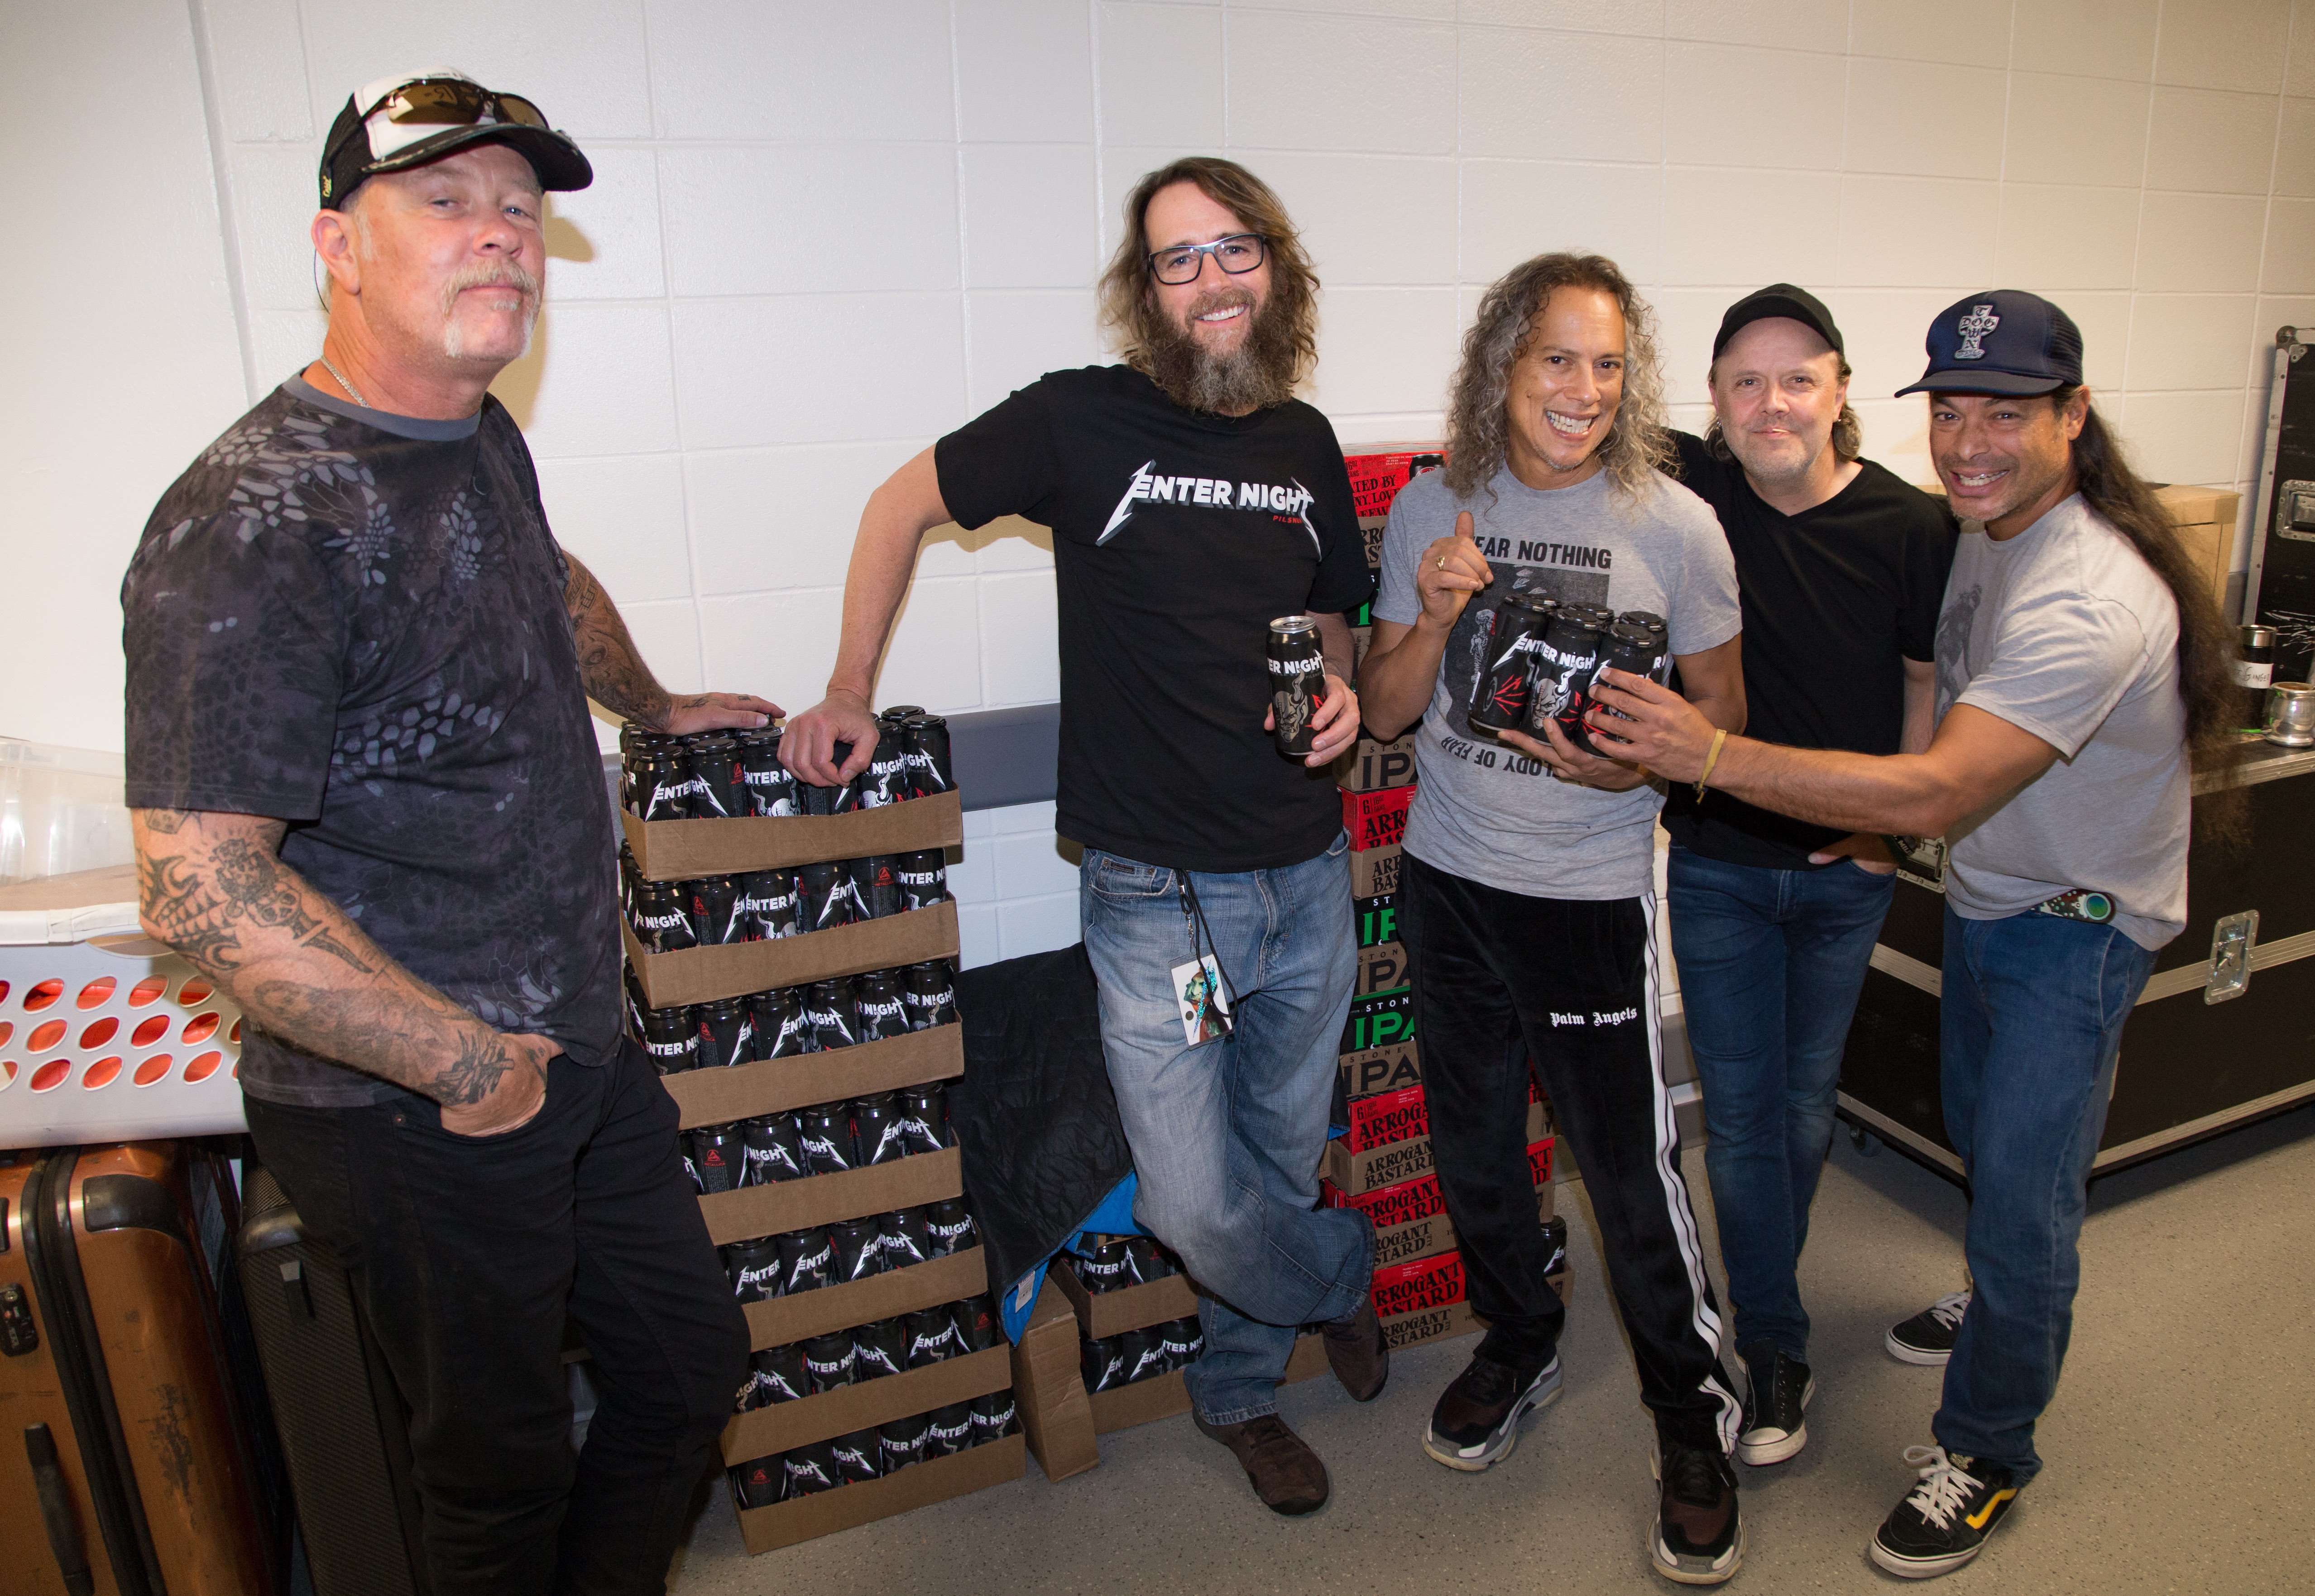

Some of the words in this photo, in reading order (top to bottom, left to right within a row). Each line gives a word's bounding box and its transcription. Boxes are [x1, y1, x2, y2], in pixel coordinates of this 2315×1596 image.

[1961, 317, 1995, 327] DOG
[1353, 478, 1379, 493] TED
[1381, 474, 1396, 488] BY
[1095, 459, 1235, 546] ENTER
[1236, 476, 1322, 562] NIGHT
[1517, 540, 1612, 570] NOTHING
[1491, 630, 1542, 672] ENT
[1284, 648, 1326, 681] NIGHT
[1369, 742, 1414, 753] STON
[1440, 736, 1474, 761] FEAR
[1474, 748, 1497, 768] OF
[905, 747, 946, 791] IGHT
[1503, 755, 1556, 777] LODY
[1362, 799, 1371, 815] 6
[645, 906, 697, 942] NIGHT
[1358, 948, 1399, 963] STON
[864, 995, 910, 1031] NIGHT
[1366, 997, 1409, 1013] STON
[1550, 1012, 1586, 1027] Palm
[1592, 1006, 1638, 1026] Angels
[1350, 1046, 1403, 1063] STONE
[1342, 1053, 1422, 1095] IPA
[1357, 1107, 1364, 1121] 6
[747, 1141, 800, 1175] NIGHT
[1365, 1140, 1433, 1177] ARROGAN
[939, 1213, 976, 1237] NIGHT
[736, 1258, 780, 1297] ENTER
[1374, 1260, 1462, 1308] RROGANT
[1381, 1280, 1459, 1318] ASTARD
[1381, 1308, 1452, 1338] RROGANT
[909, 1332, 952, 1358] ENTER
[806, 1356, 838, 1373] NTER
[928, 1423, 968, 1443] ENTER
